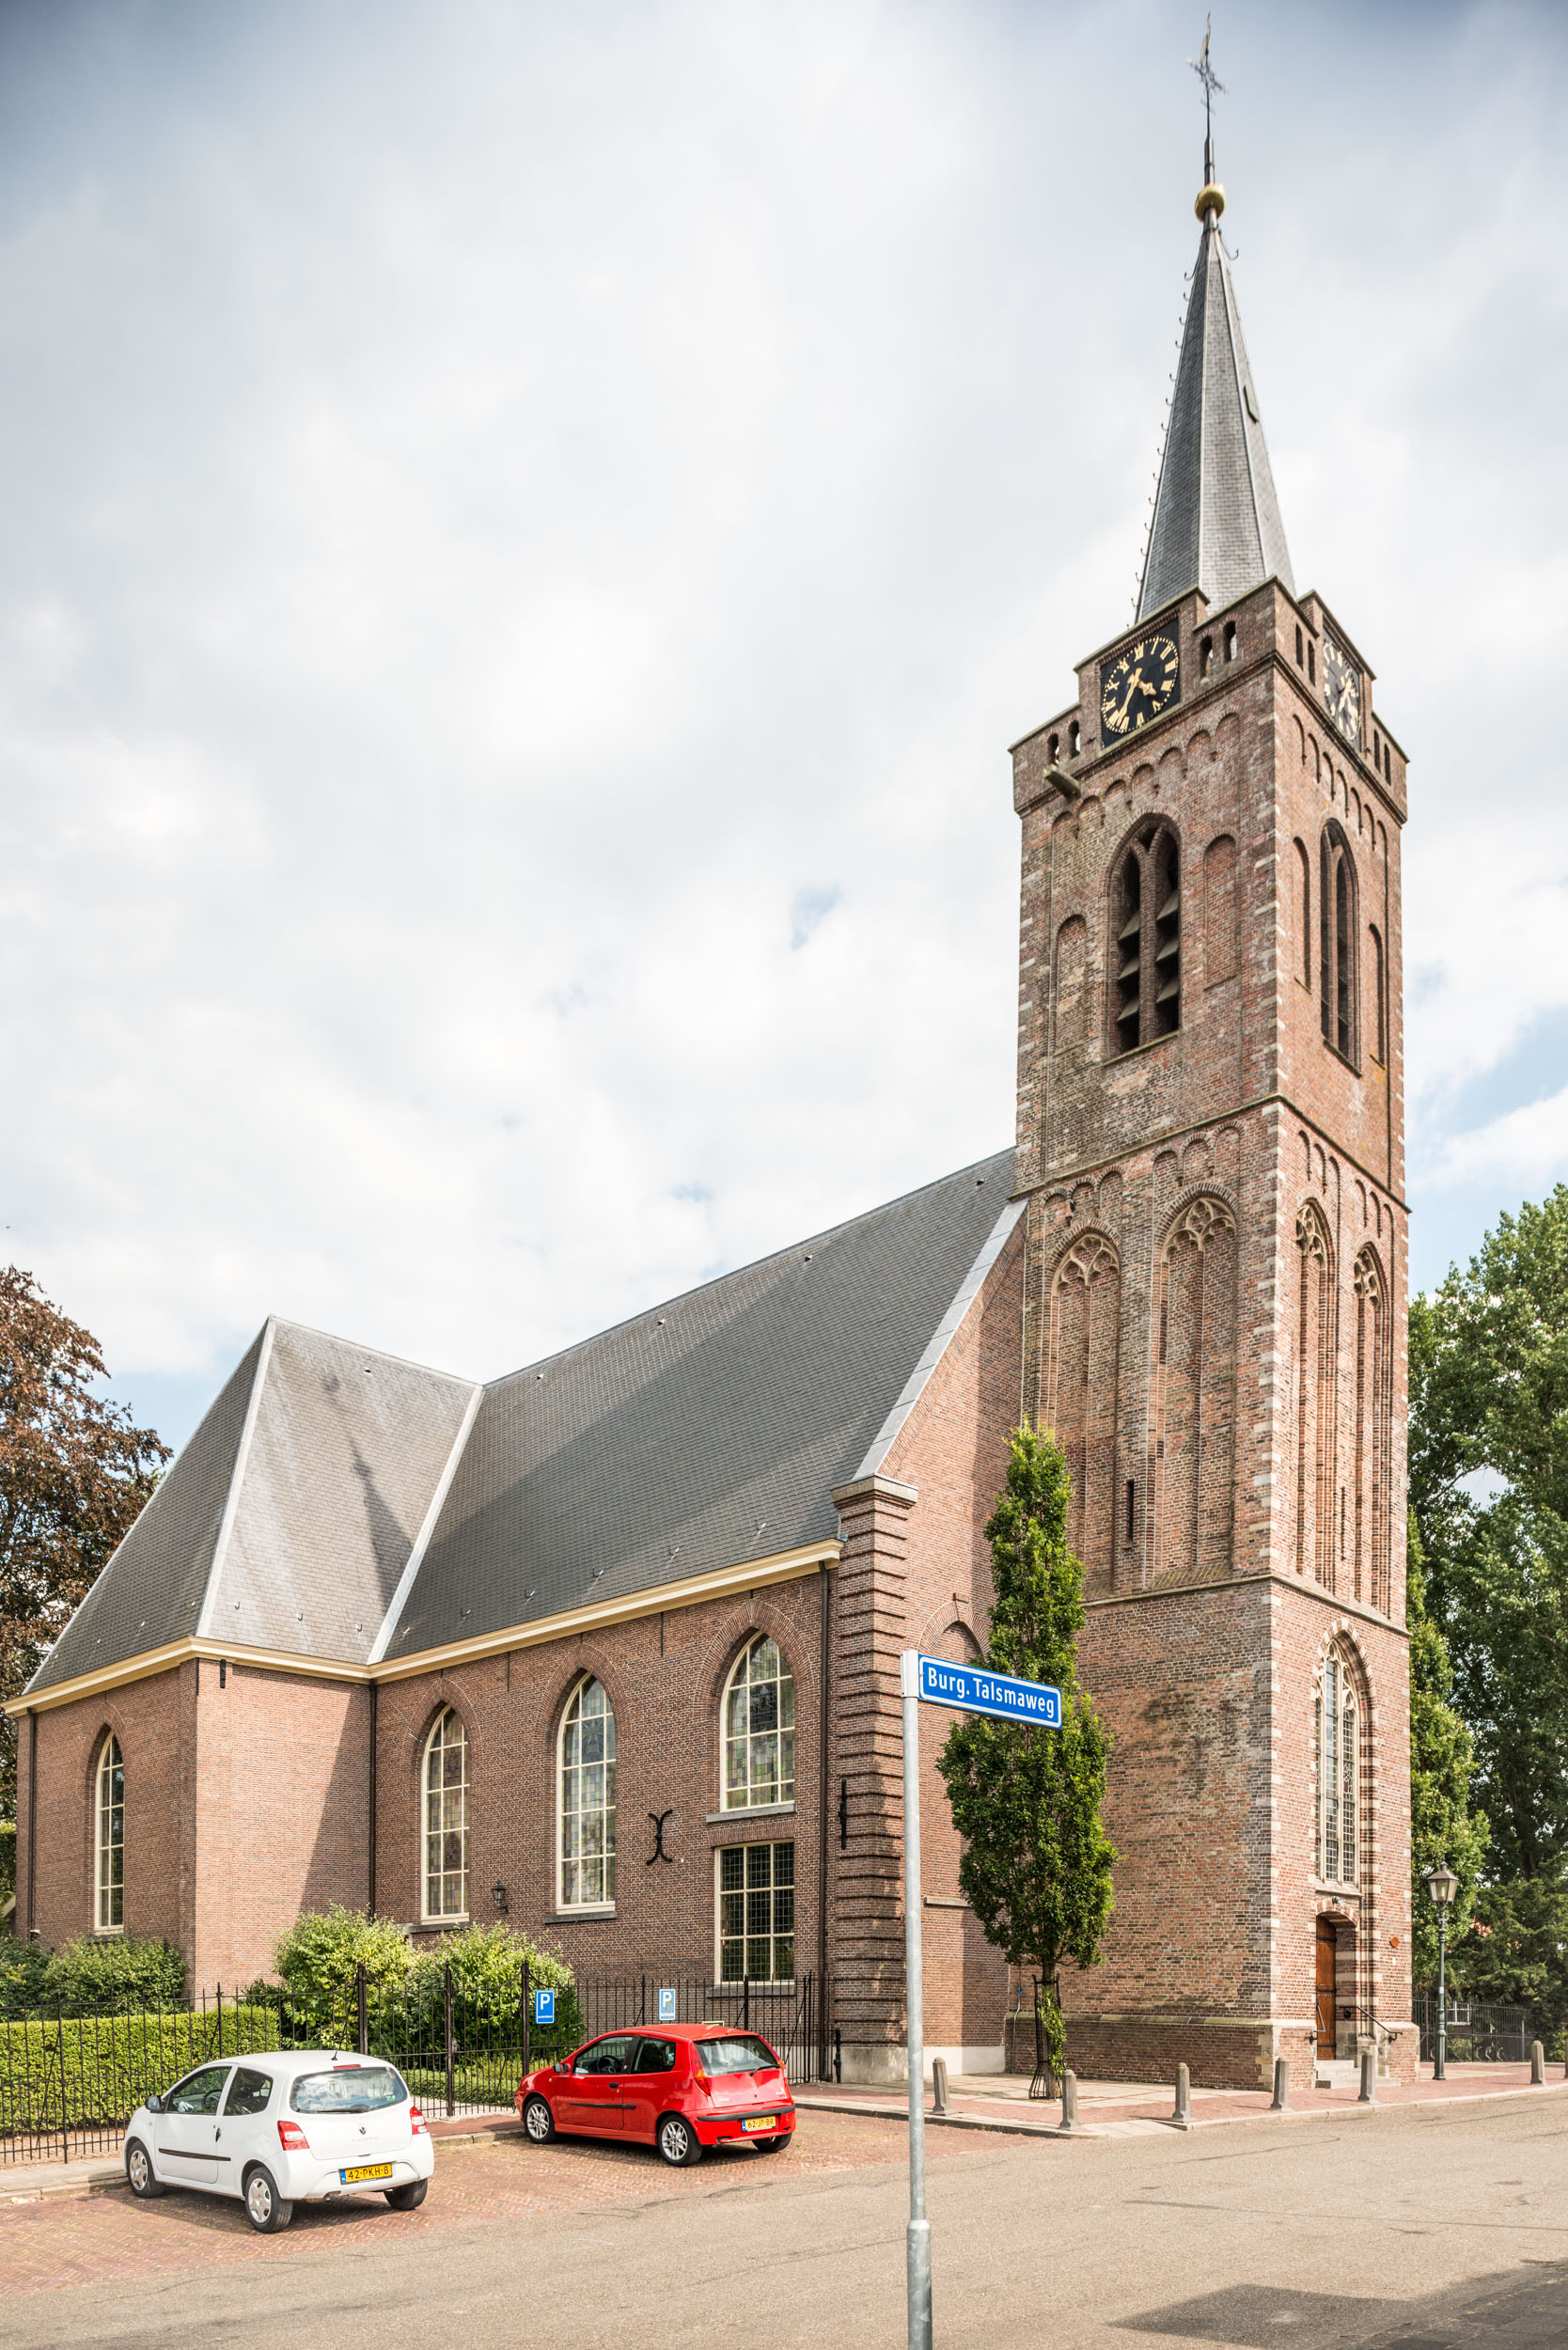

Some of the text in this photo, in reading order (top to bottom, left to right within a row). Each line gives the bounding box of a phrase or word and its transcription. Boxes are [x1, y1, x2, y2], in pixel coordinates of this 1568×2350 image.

[928, 1667, 1055, 1719] Burg. Talsmaweg
[540, 1993, 551, 2011] P
[662, 1991, 672, 2009] P
[348, 2165, 389, 2180] 42-PKH-8
